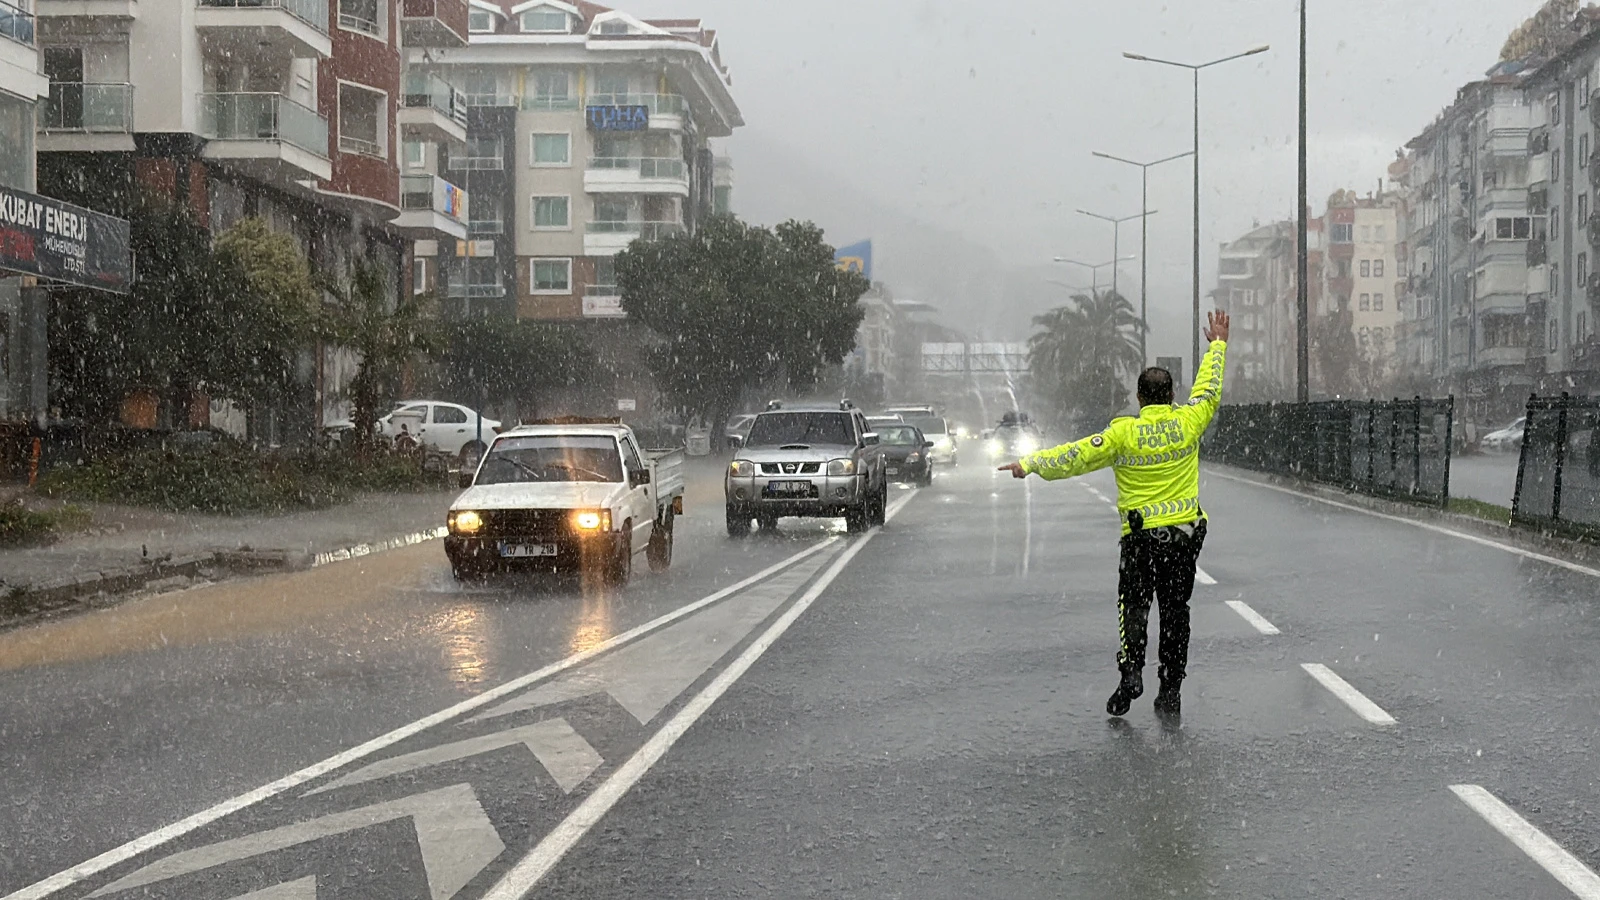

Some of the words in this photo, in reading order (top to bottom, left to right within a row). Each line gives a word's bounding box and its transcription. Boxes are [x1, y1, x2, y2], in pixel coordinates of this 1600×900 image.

[0, 192, 43, 230] KUBAT
[506, 544, 516, 555] 07
[541, 544, 555, 555] 218
